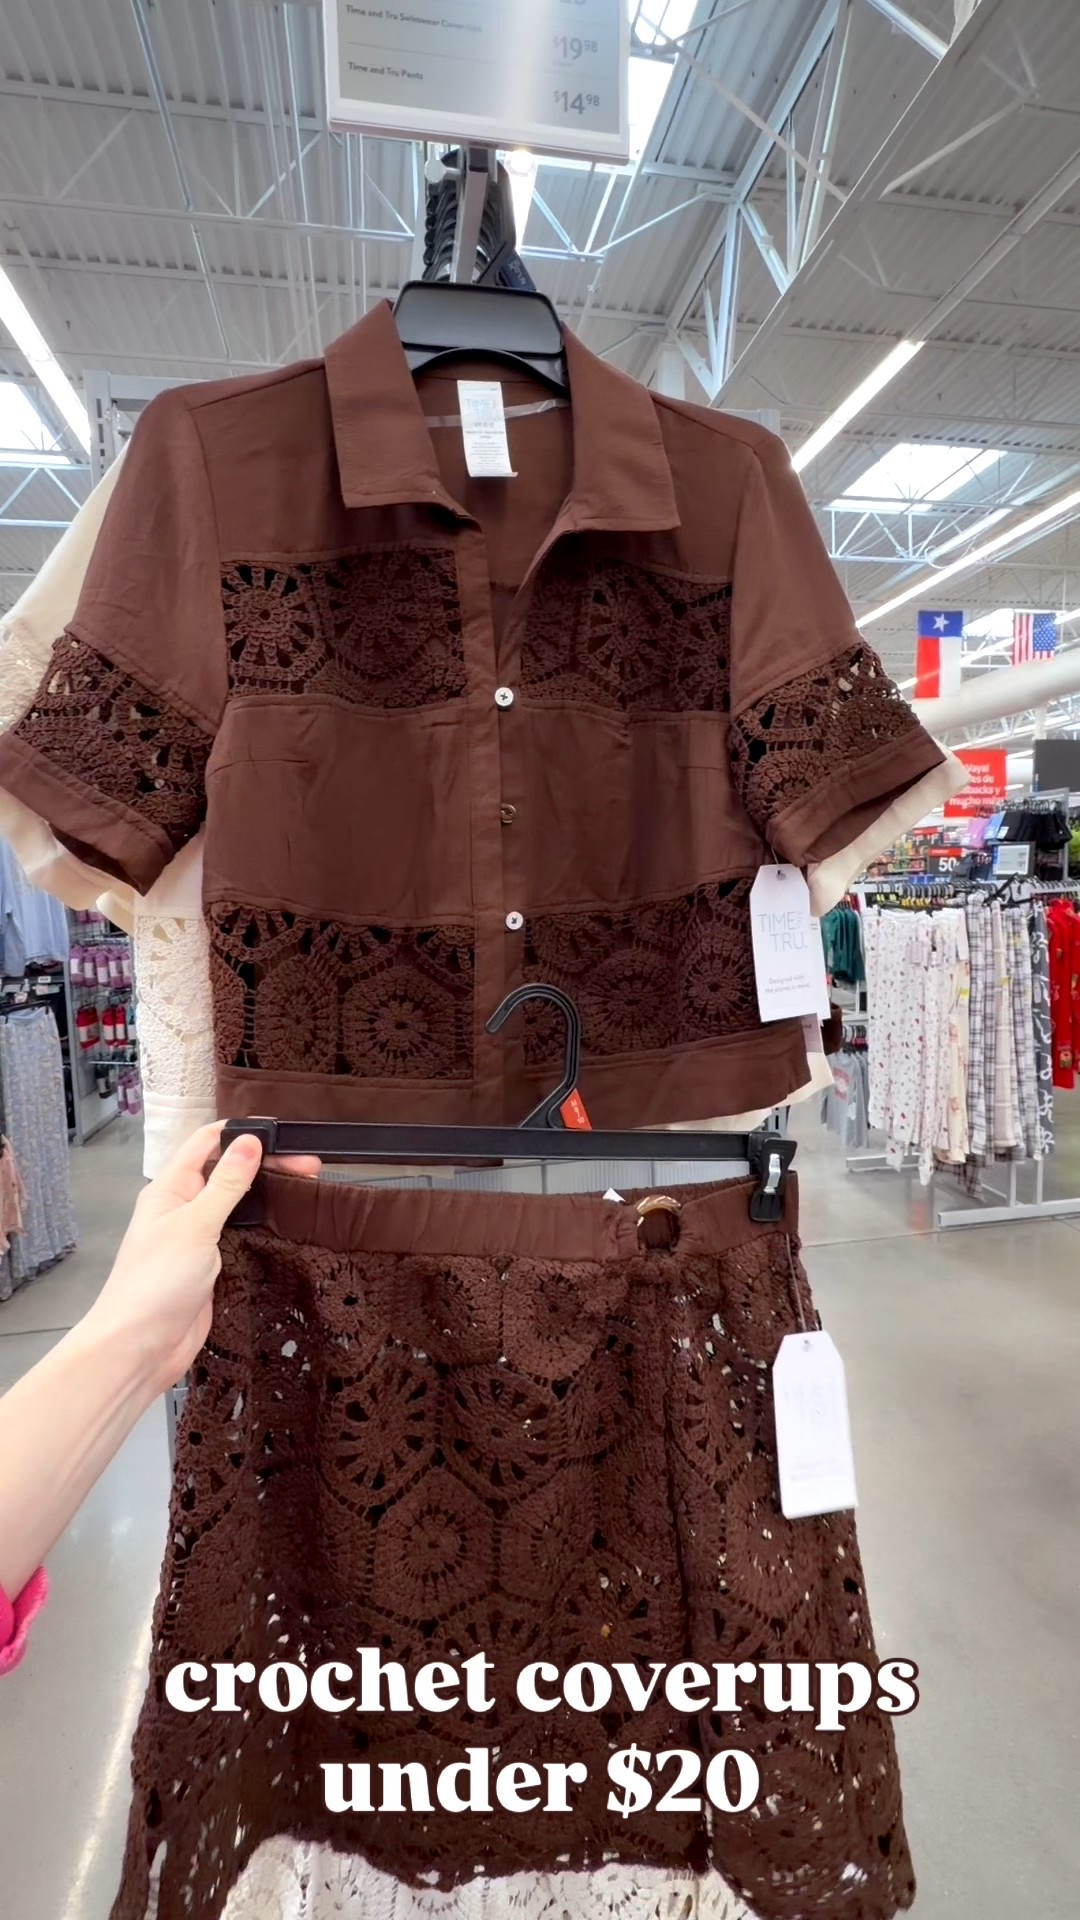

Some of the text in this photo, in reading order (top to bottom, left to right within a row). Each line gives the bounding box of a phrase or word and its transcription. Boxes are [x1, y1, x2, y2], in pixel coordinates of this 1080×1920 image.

[345, 4, 366, 16] Time
[368, 9, 383, 18] and
[385, 11, 398, 21] Tru
[348, 61, 424, 81] Time and Tru Pants
[757, 911, 797, 933] TIME
